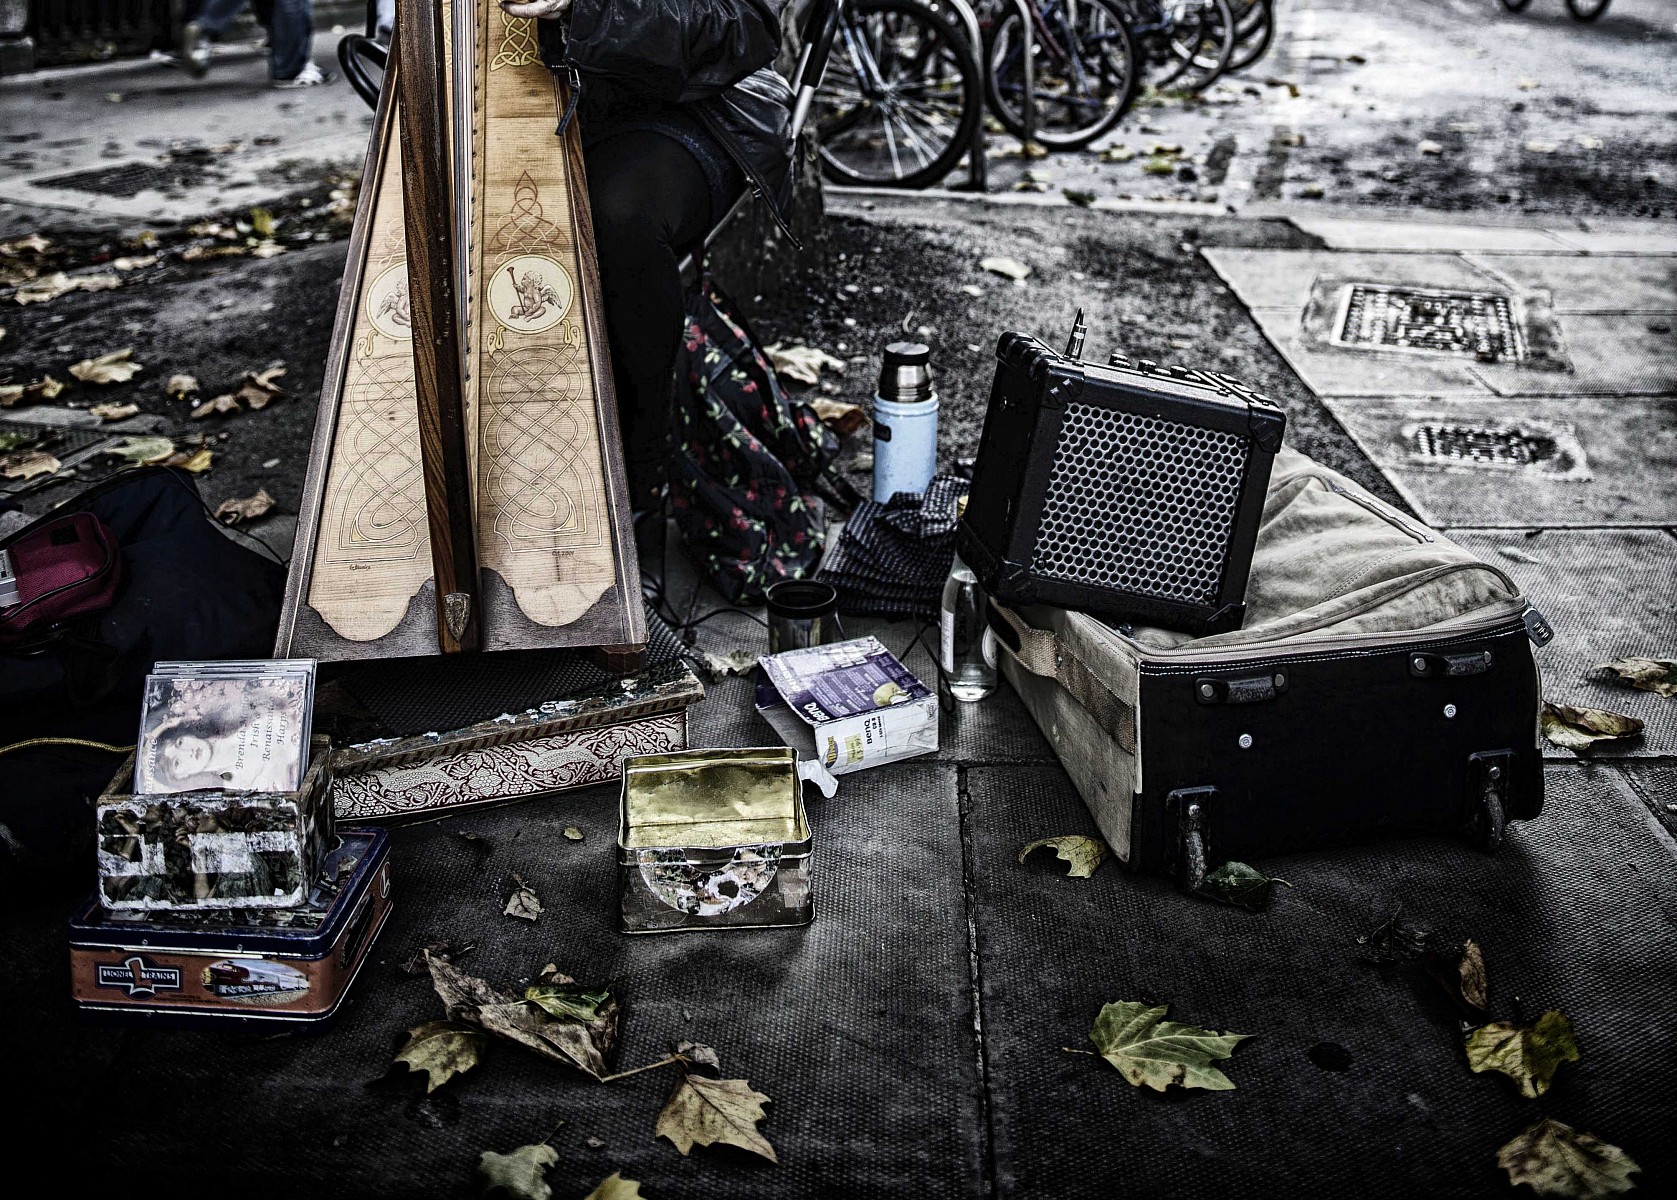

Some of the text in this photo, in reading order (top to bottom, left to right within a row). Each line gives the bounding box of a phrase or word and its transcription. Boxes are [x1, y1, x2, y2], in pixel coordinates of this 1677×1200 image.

[803, 702, 831, 722] BenQ
[250, 722, 260, 748] Irish
[262, 697, 275, 761] Renaissance
[277, 711, 288, 745] Harps
[864, 719, 873, 745] BenQ
[235, 729, 246, 769] Brenda
[103, 969, 176, 980] LIONEL TRAINS
